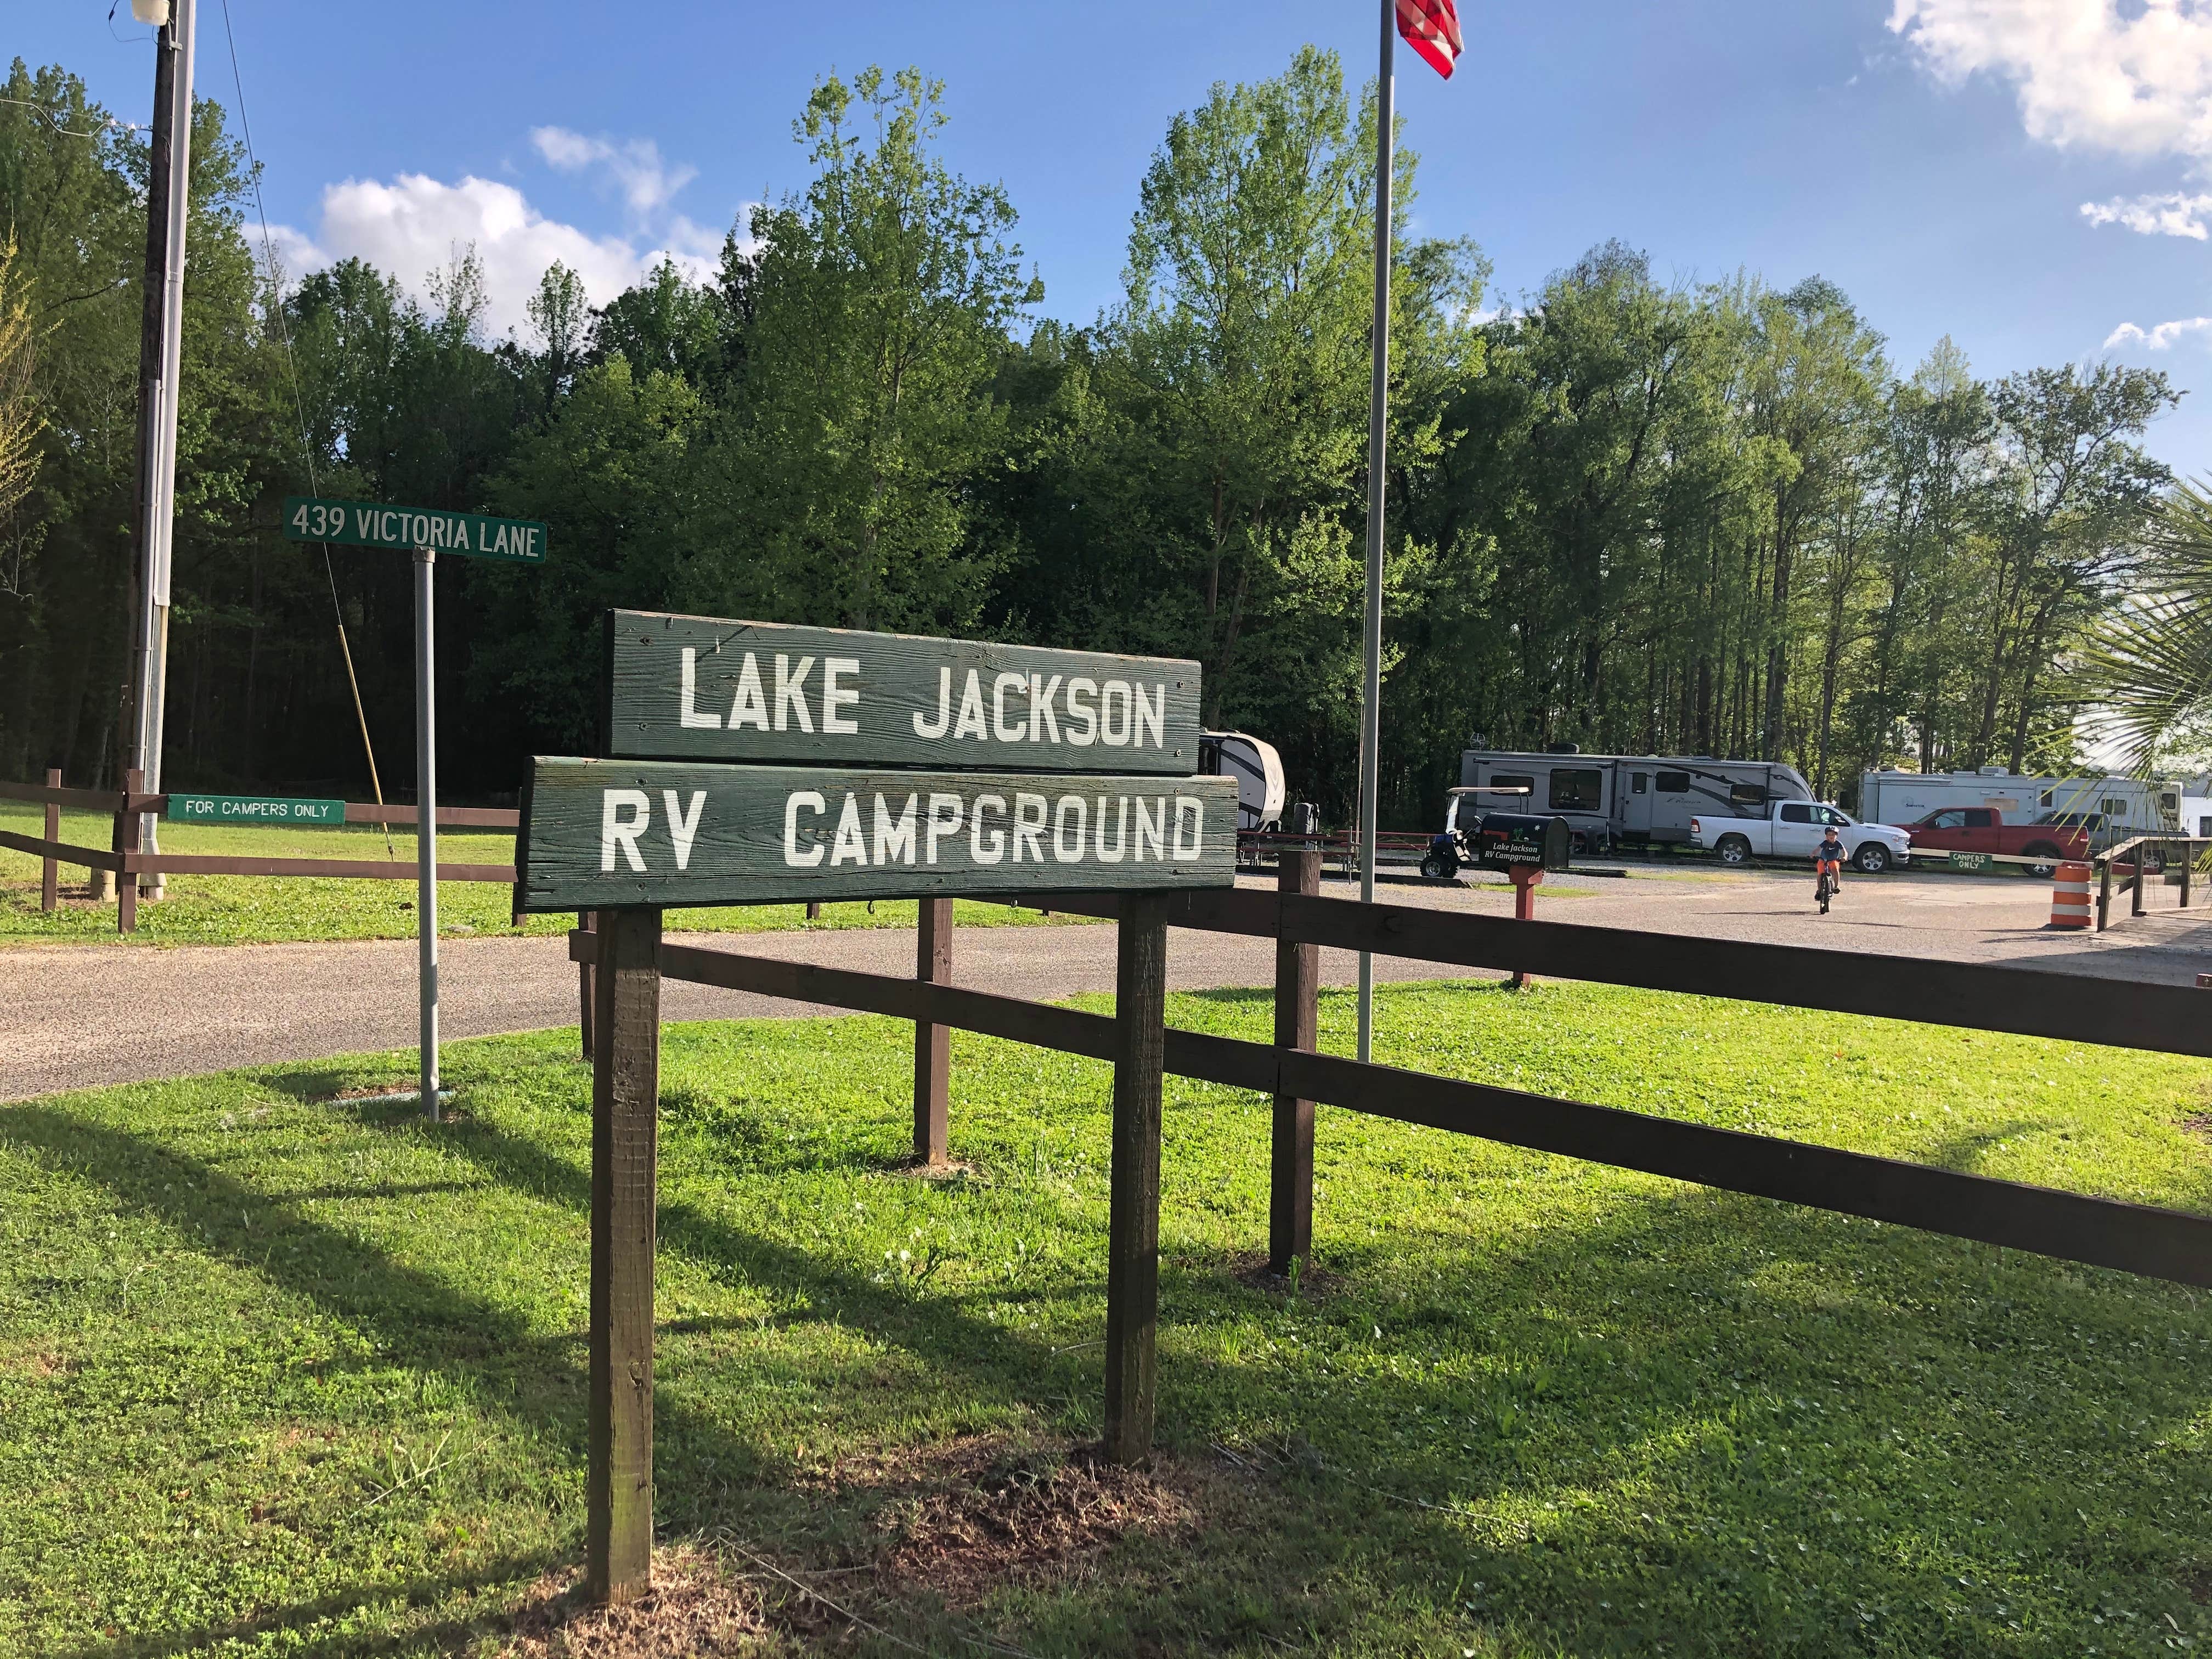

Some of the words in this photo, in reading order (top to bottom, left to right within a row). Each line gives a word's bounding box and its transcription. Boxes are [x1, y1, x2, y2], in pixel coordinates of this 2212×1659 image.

[292, 505, 346, 537] 439
[357, 509, 469, 550] VICTORIA
[479, 522, 540, 557] LANE
[680, 647, 860, 735] LAKE
[912, 666, 1165, 749] JACKSON
[186, 800, 215, 814] FOR
[222, 802, 288, 816] CAMPERS
[295, 804, 329, 817] ONLY
[600, 788, 708, 872] RV
[785, 791, 1204, 867] CAMPGROUND
[1493, 843, 1509, 851] Lake
[1510, 844, 1538, 853] Jackson
[1495, 851, 1541, 862] Campground
[1953, 853, 1985, 864] CAMPERS
[1959, 860, 1979, 870] ONLY
